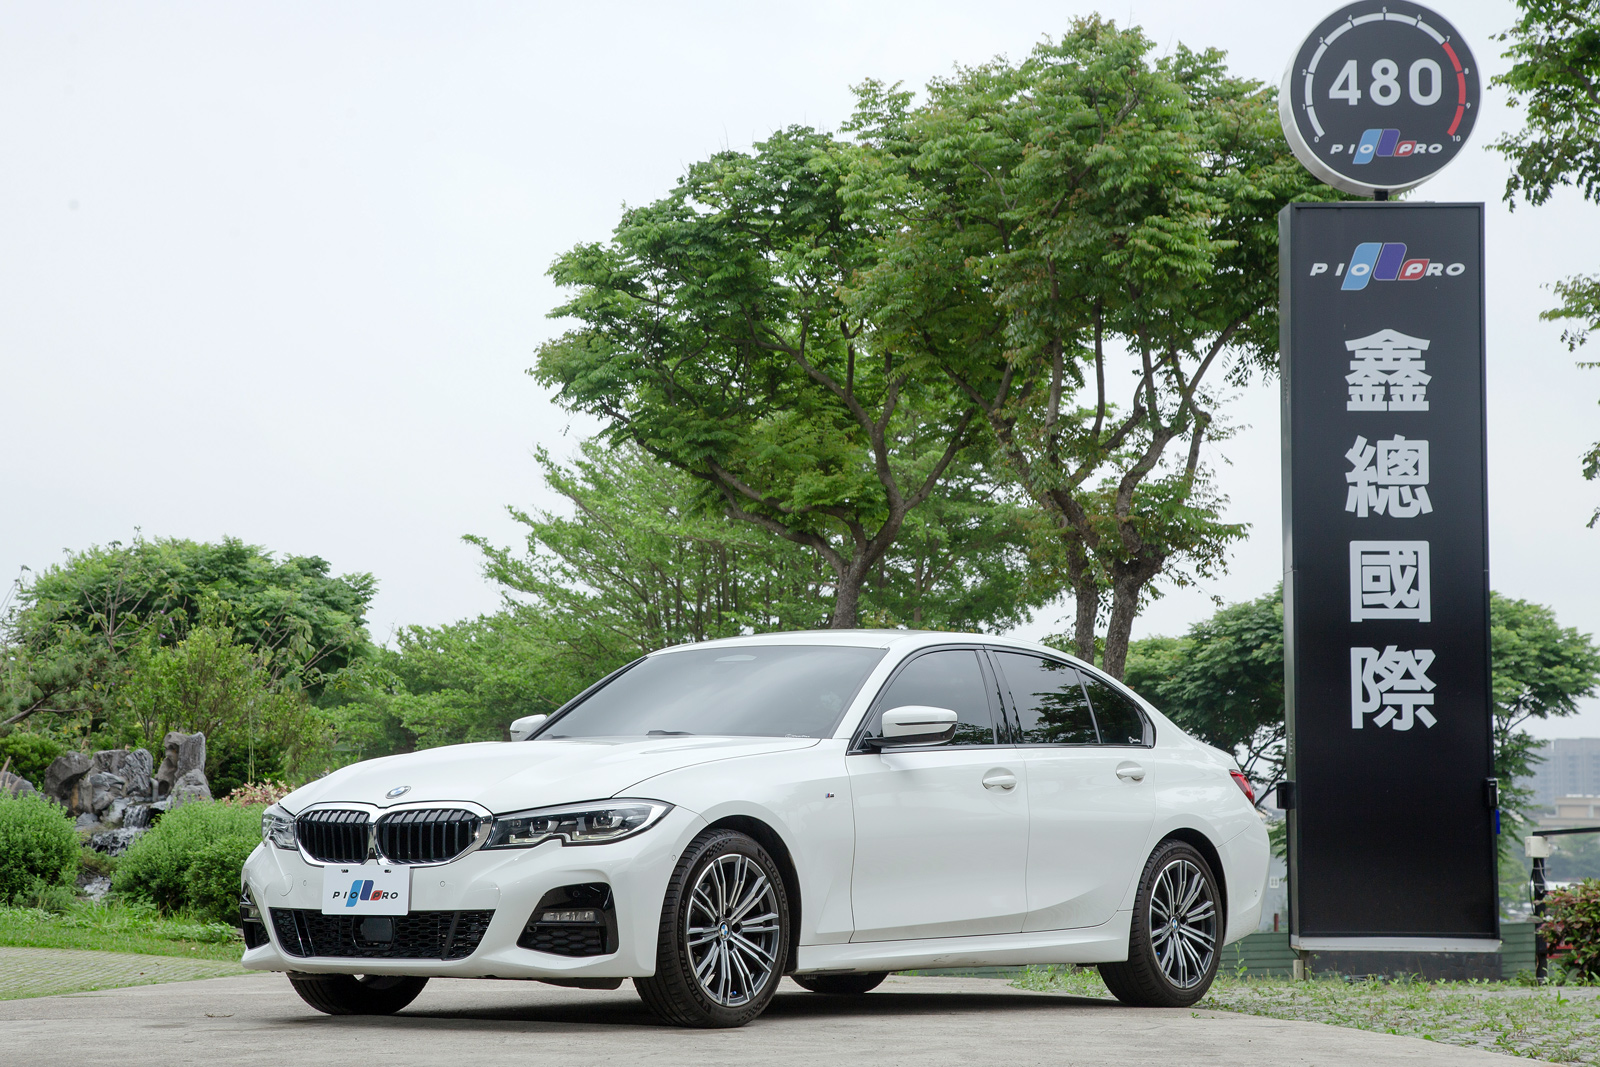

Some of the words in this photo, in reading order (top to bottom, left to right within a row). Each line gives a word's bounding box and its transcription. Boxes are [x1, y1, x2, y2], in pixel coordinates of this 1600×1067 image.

[1329, 58, 1442, 106] 480
[1330, 144, 1374, 155] PIO
[1399, 143, 1443, 154] PRO
[1310, 262, 1370, 277] PIO
[1405, 262, 1466, 277] PRO
[1345, 329, 1437, 731] 鑫總國際
[332, 891, 358, 899] PIO
[372, 891, 399, 899] PRO
[767, 861, 787, 911] MICHELIN
[680, 950, 709, 1004] MICHELIN
